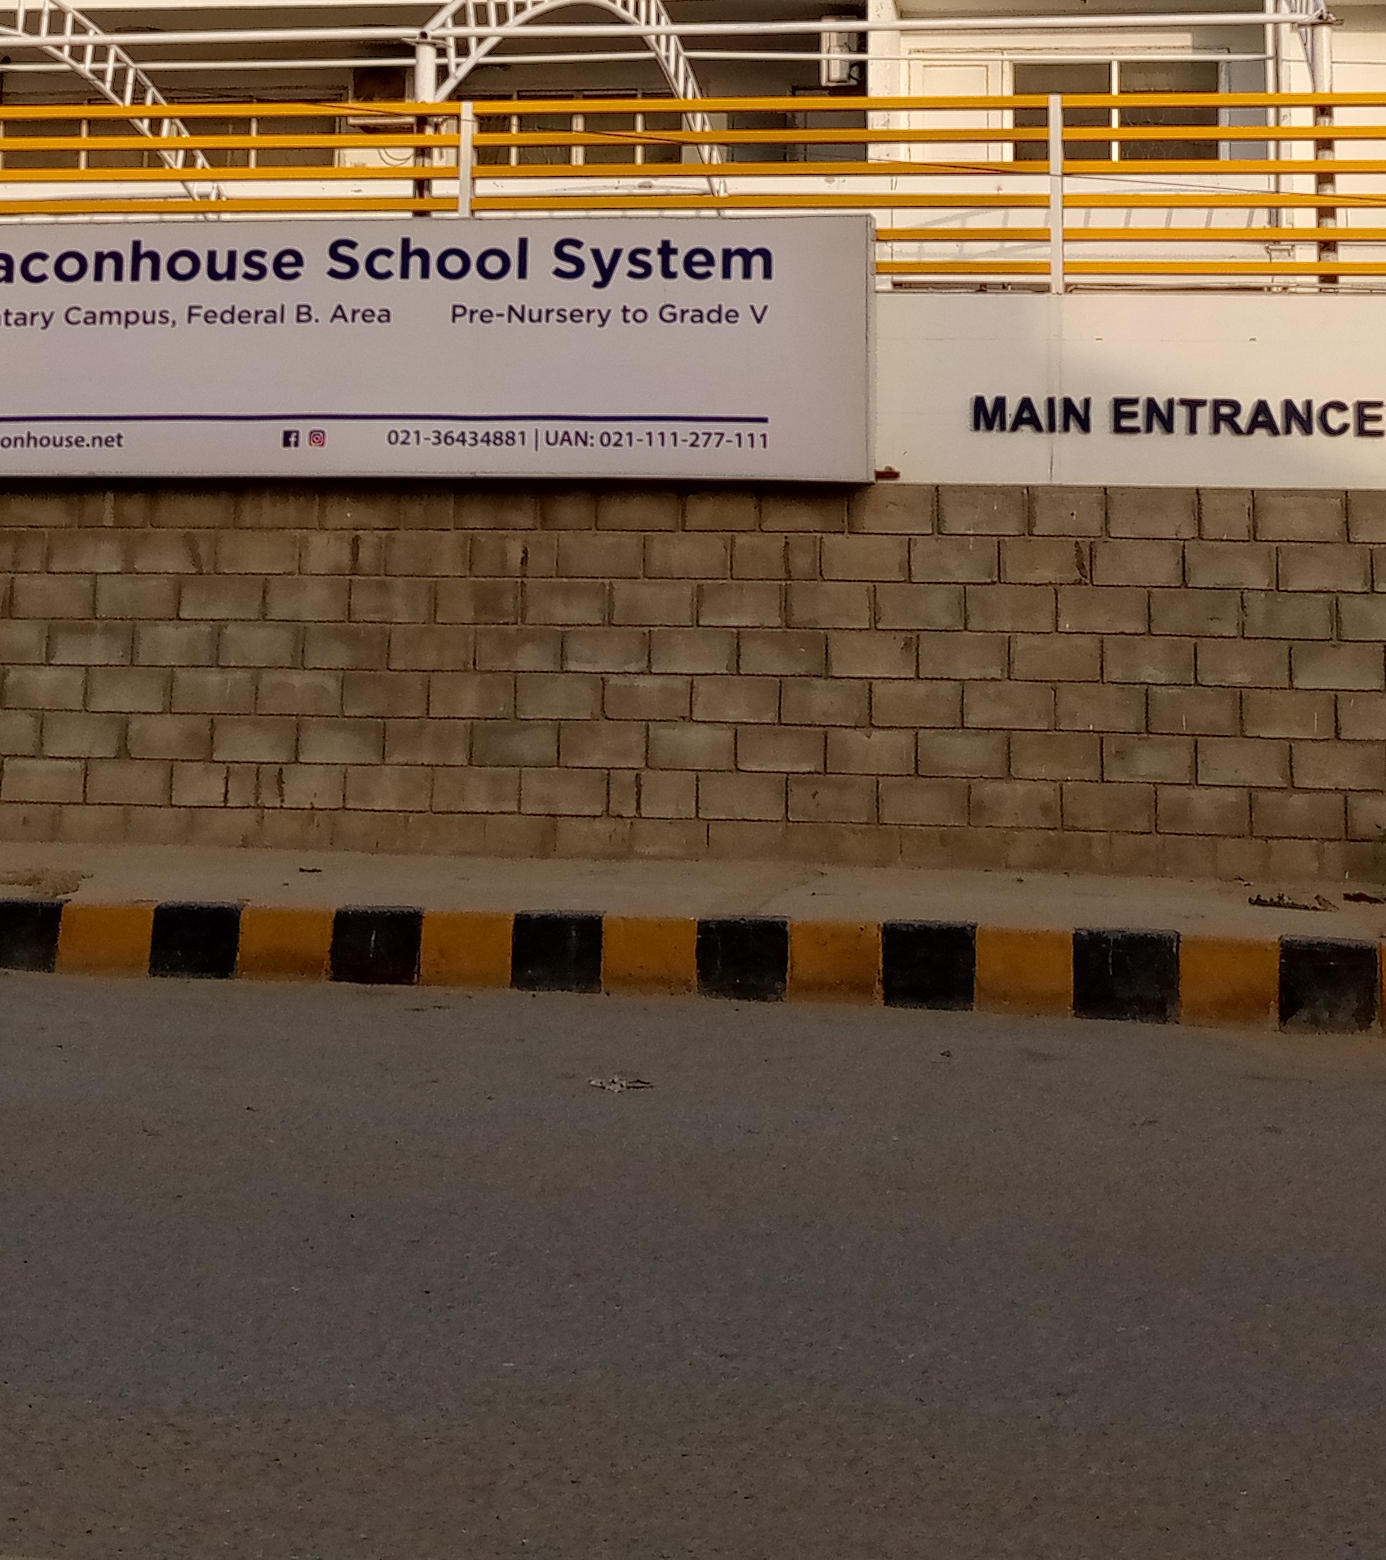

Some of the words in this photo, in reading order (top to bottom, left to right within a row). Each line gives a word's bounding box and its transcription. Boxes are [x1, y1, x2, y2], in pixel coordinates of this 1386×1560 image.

[326, 237, 529, 281] School
[552, 237, 774, 289] System
[64, 306, 177, 329] Campus,
[187, 304, 285, 325] Federal
[296, 305, 319, 324] B.
[329, 304, 392, 324] Area
[451, 304, 611, 327] Pre-Nursery
[622, 306, 648, 324] to
[658, 304, 740, 324] Grade
[749, 305, 769, 324] V
[974, 395, 1091, 434] MAIN
[1113, 397, 1385, 437] ENTRANCE
[387, 429, 527, 447] 021-36434881
[546, 430, 595, 447] UAN:
[600, 430, 769, 449] 021-111-277-111
